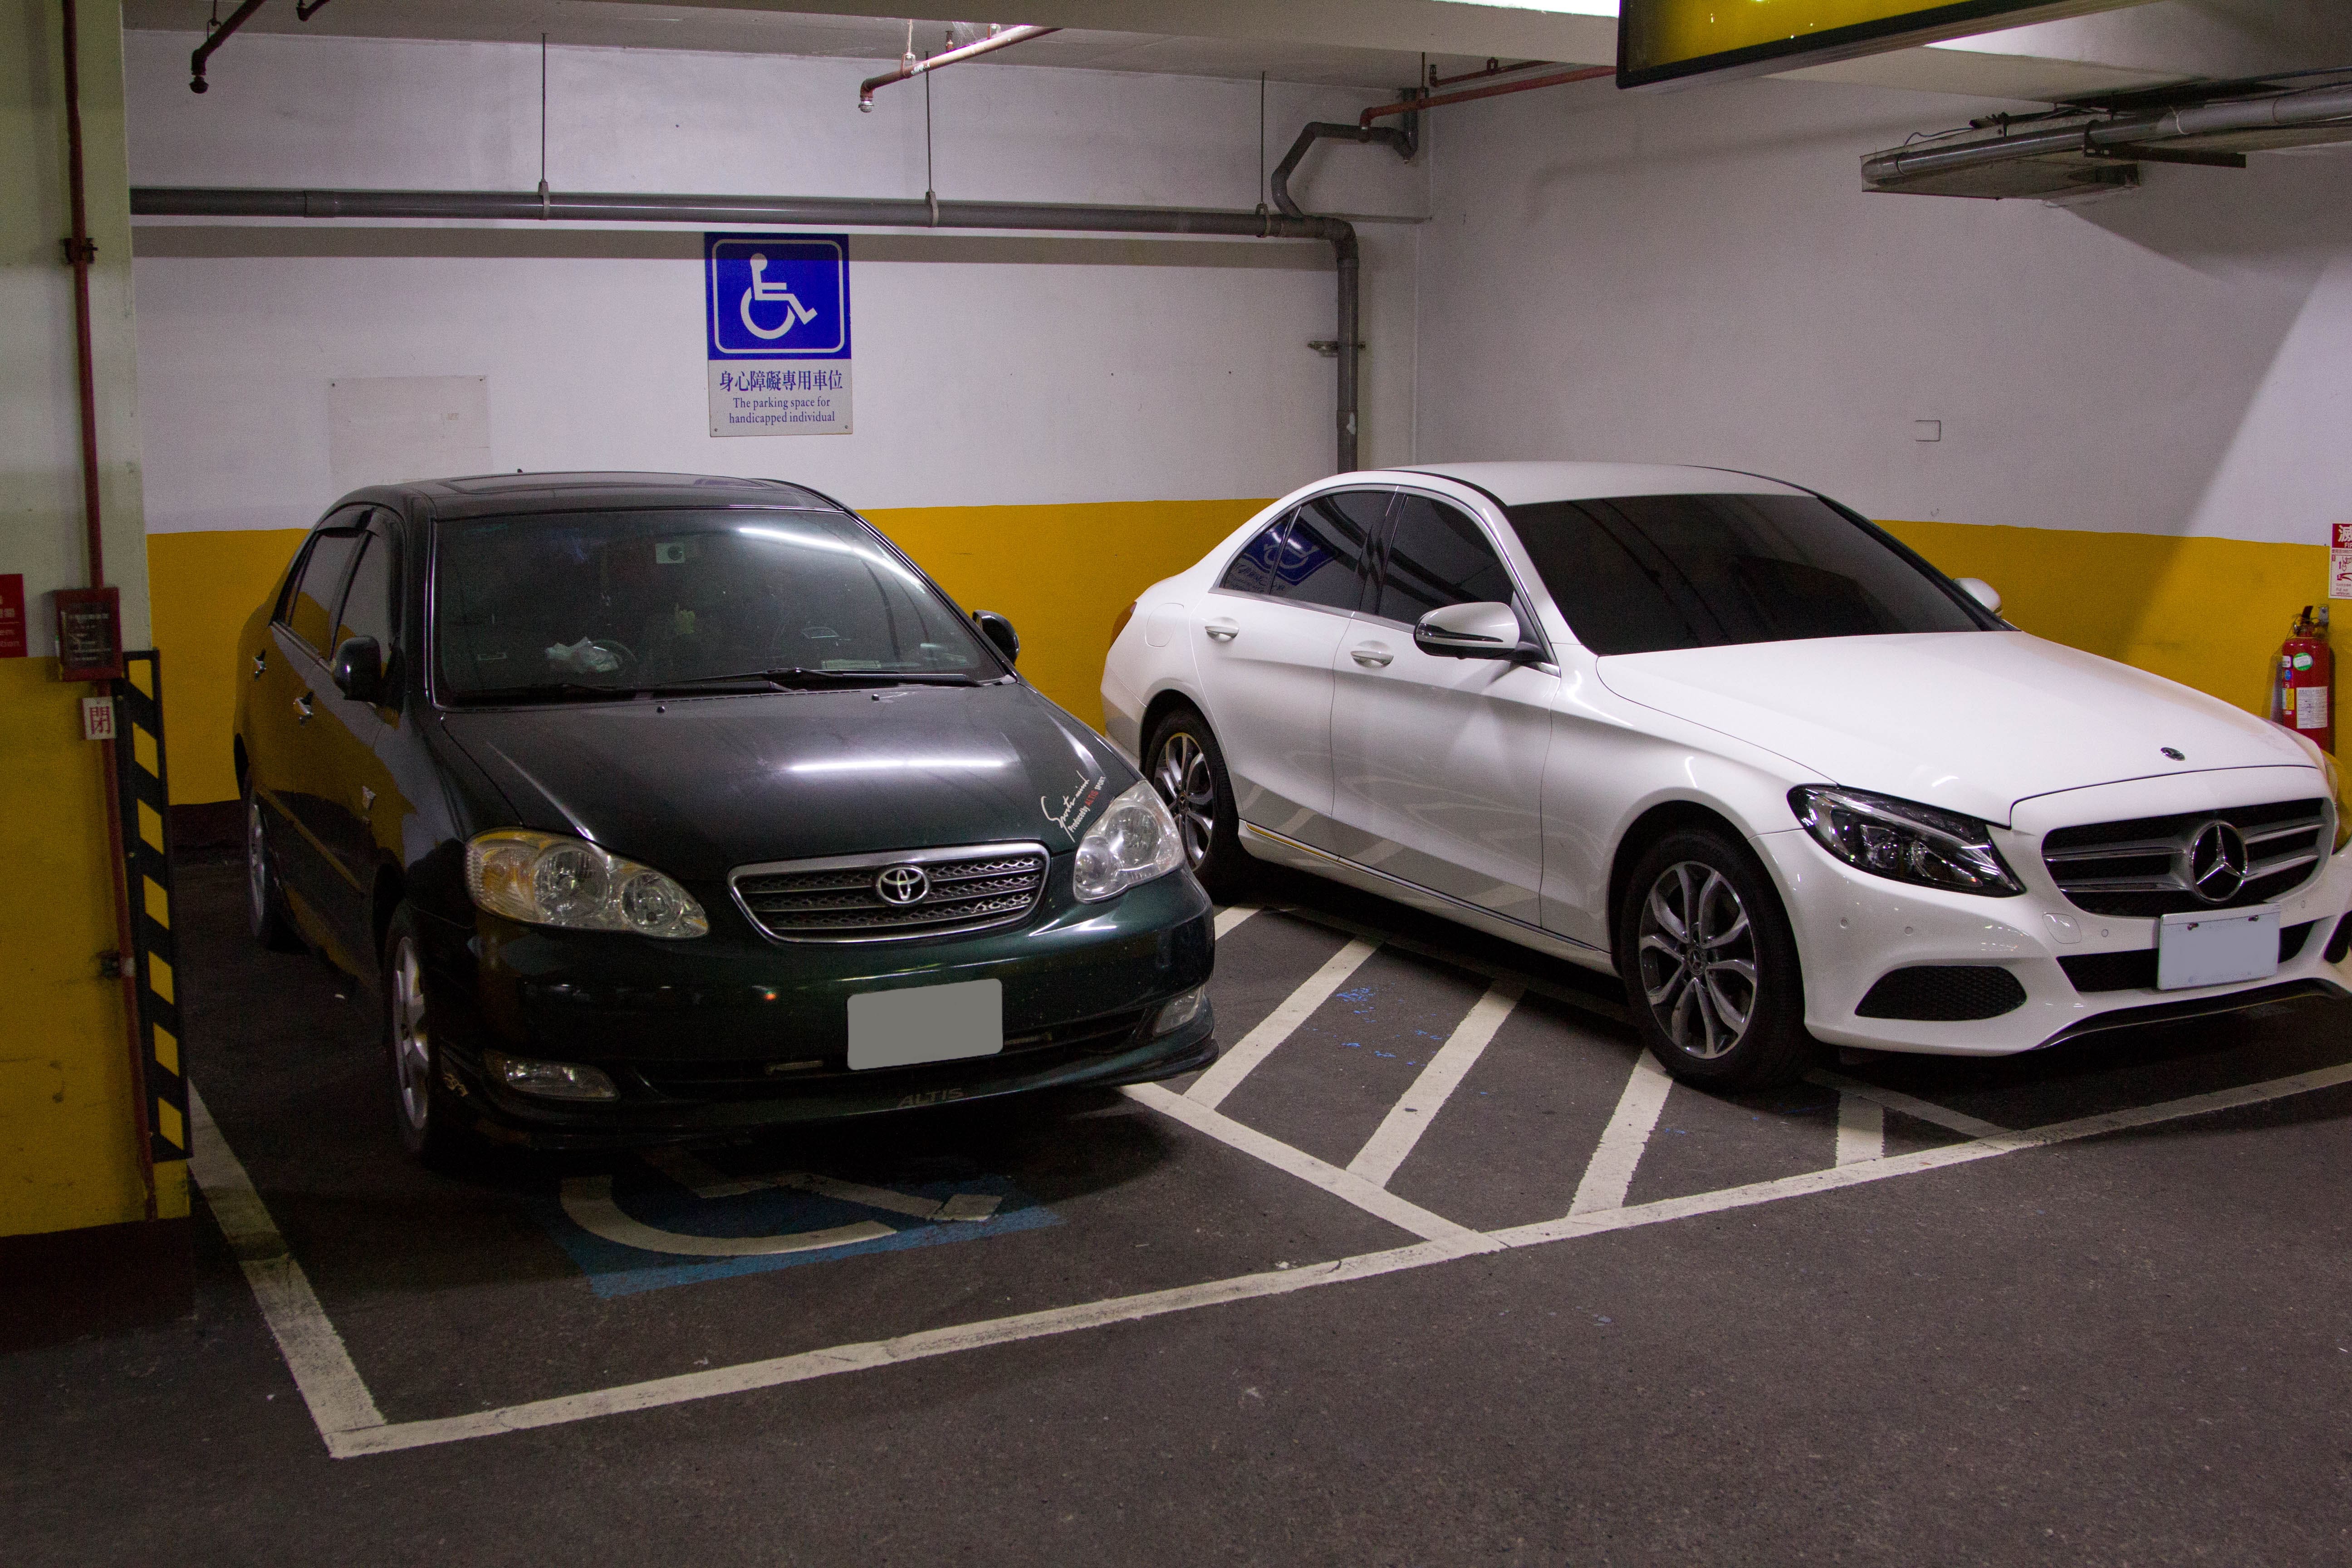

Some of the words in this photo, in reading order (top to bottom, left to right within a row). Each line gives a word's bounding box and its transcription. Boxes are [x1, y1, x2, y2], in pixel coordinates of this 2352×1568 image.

[720, 370, 843, 392] 身心障礙專用車位
[733, 397, 750, 408] The
[753, 397, 788, 410] parking
[790, 397, 815, 410] space
[817, 396, 830, 407] for
[729, 412, 787, 426] handicapped
[789, 411, 835, 422] individual
[1085, 790, 1099, 806] ALTIS
[1094, 776, 1106, 790] SPORT
[897, 1088, 965, 1108] ALTIS
